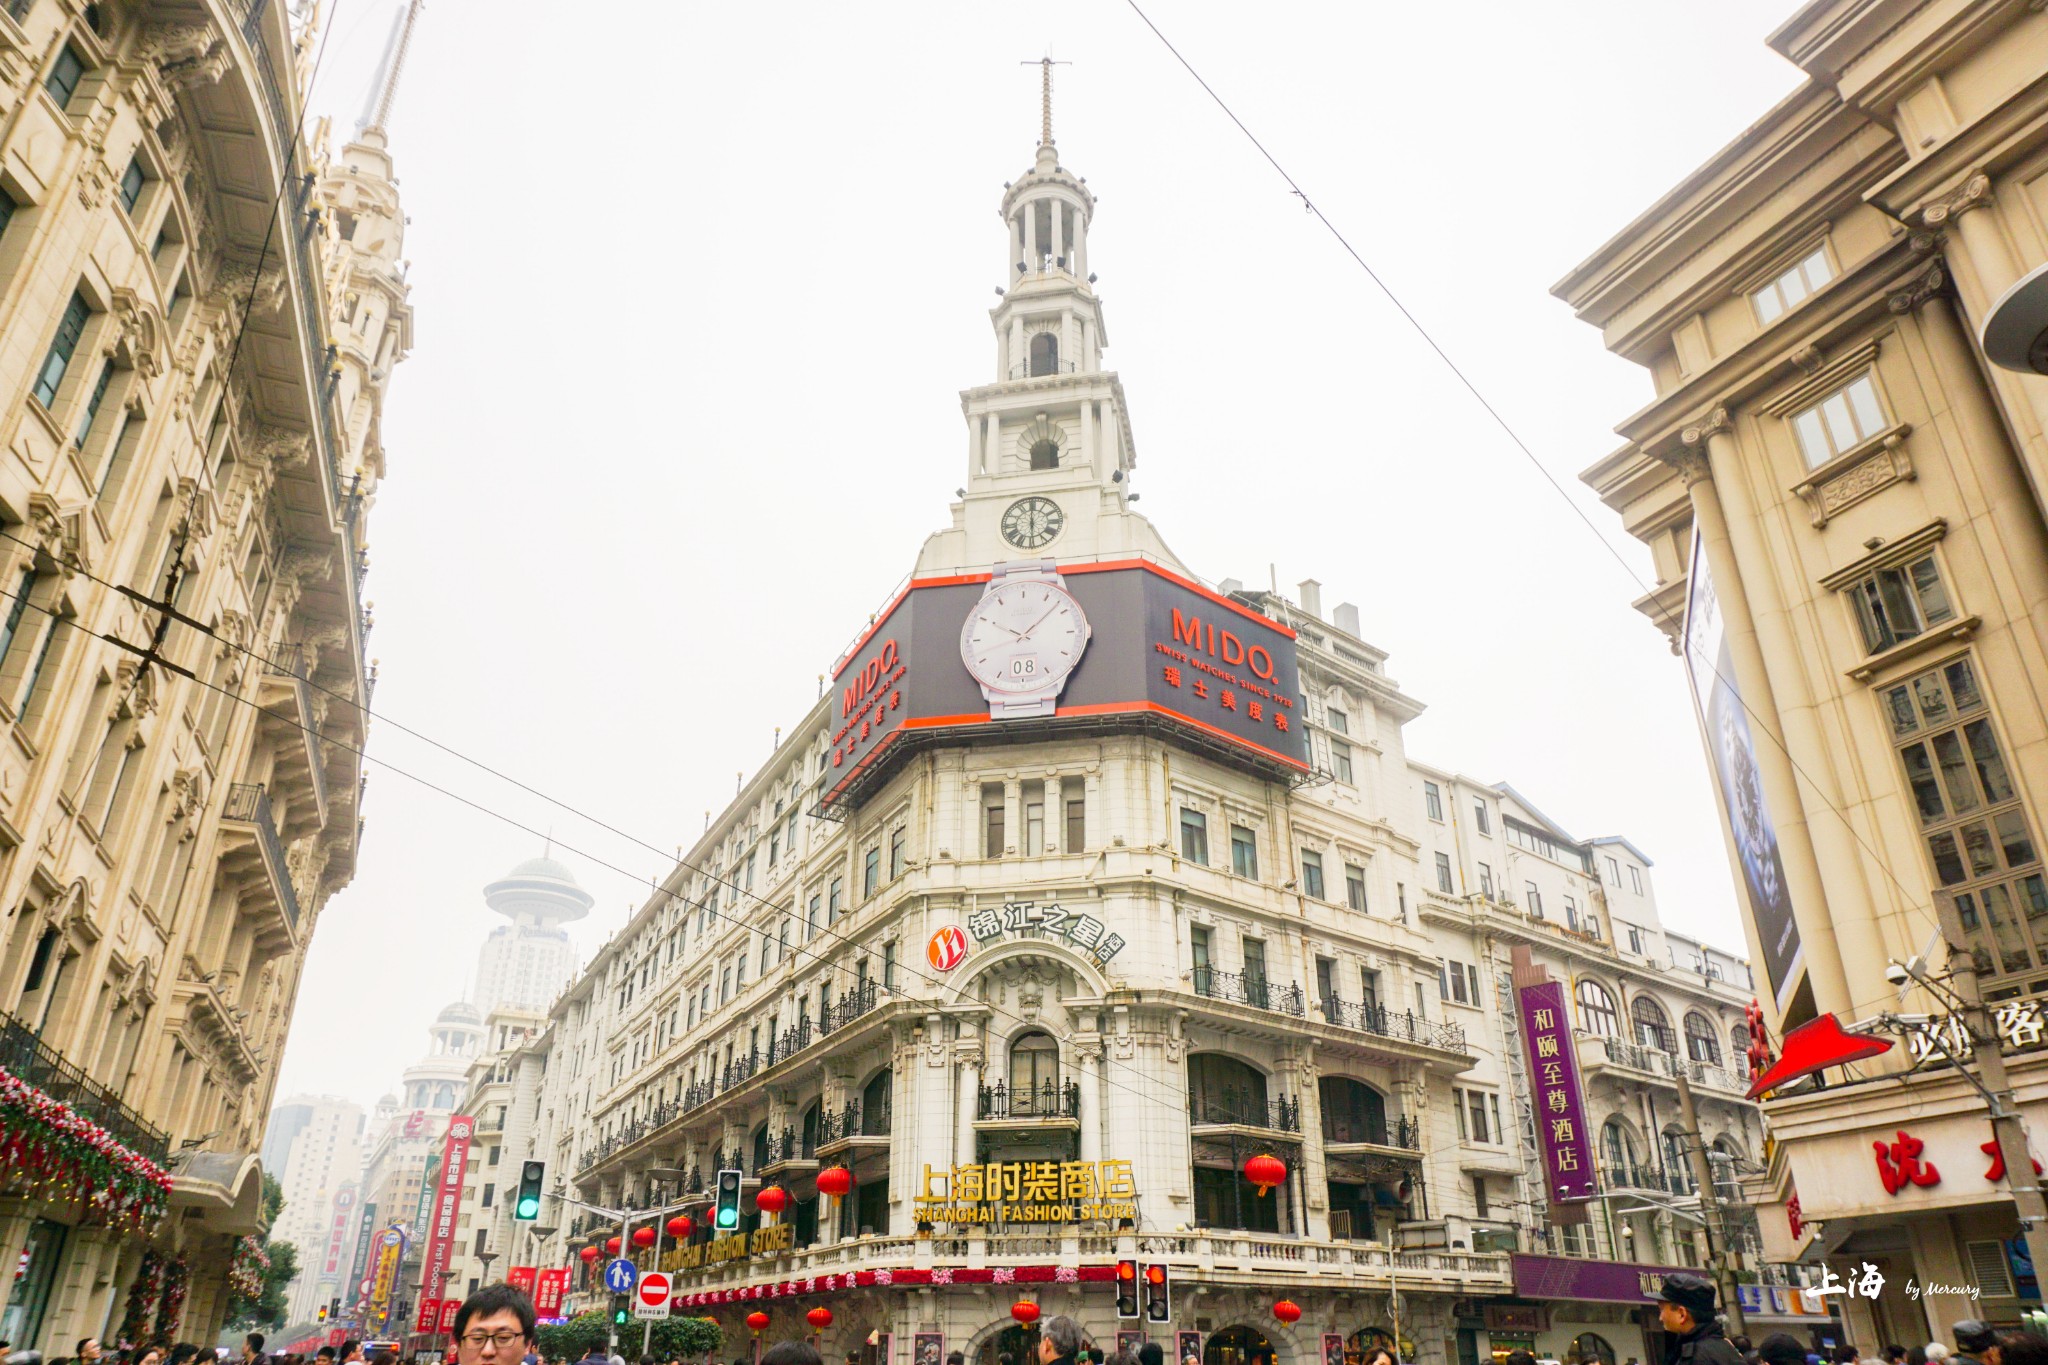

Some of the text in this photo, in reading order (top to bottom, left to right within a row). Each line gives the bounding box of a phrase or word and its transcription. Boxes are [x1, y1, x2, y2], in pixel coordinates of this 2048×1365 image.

[1155, 642, 1187, 663] SWISS
[1191, 657, 1237, 684] WATCHES
[1239, 679, 1270, 698] SINCE
[1164, 666, 1289, 732] 瑞士美度表
[969, 901, 1105, 951] 锦江之星
[1910, 1002, 2044, 1062] 必客
[1533, 1008, 1579, 1173] 和颐至尊酒店
[913, 1159, 1134, 1202] 上海时装商店
[912, 1202, 1136, 1223] SHANGHAI FASHION STORE
[662, 1245, 702, 1272] SHANGHAI
[705, 1232, 749, 1264] FASHION
[751, 1222, 792, 1254] STORE
